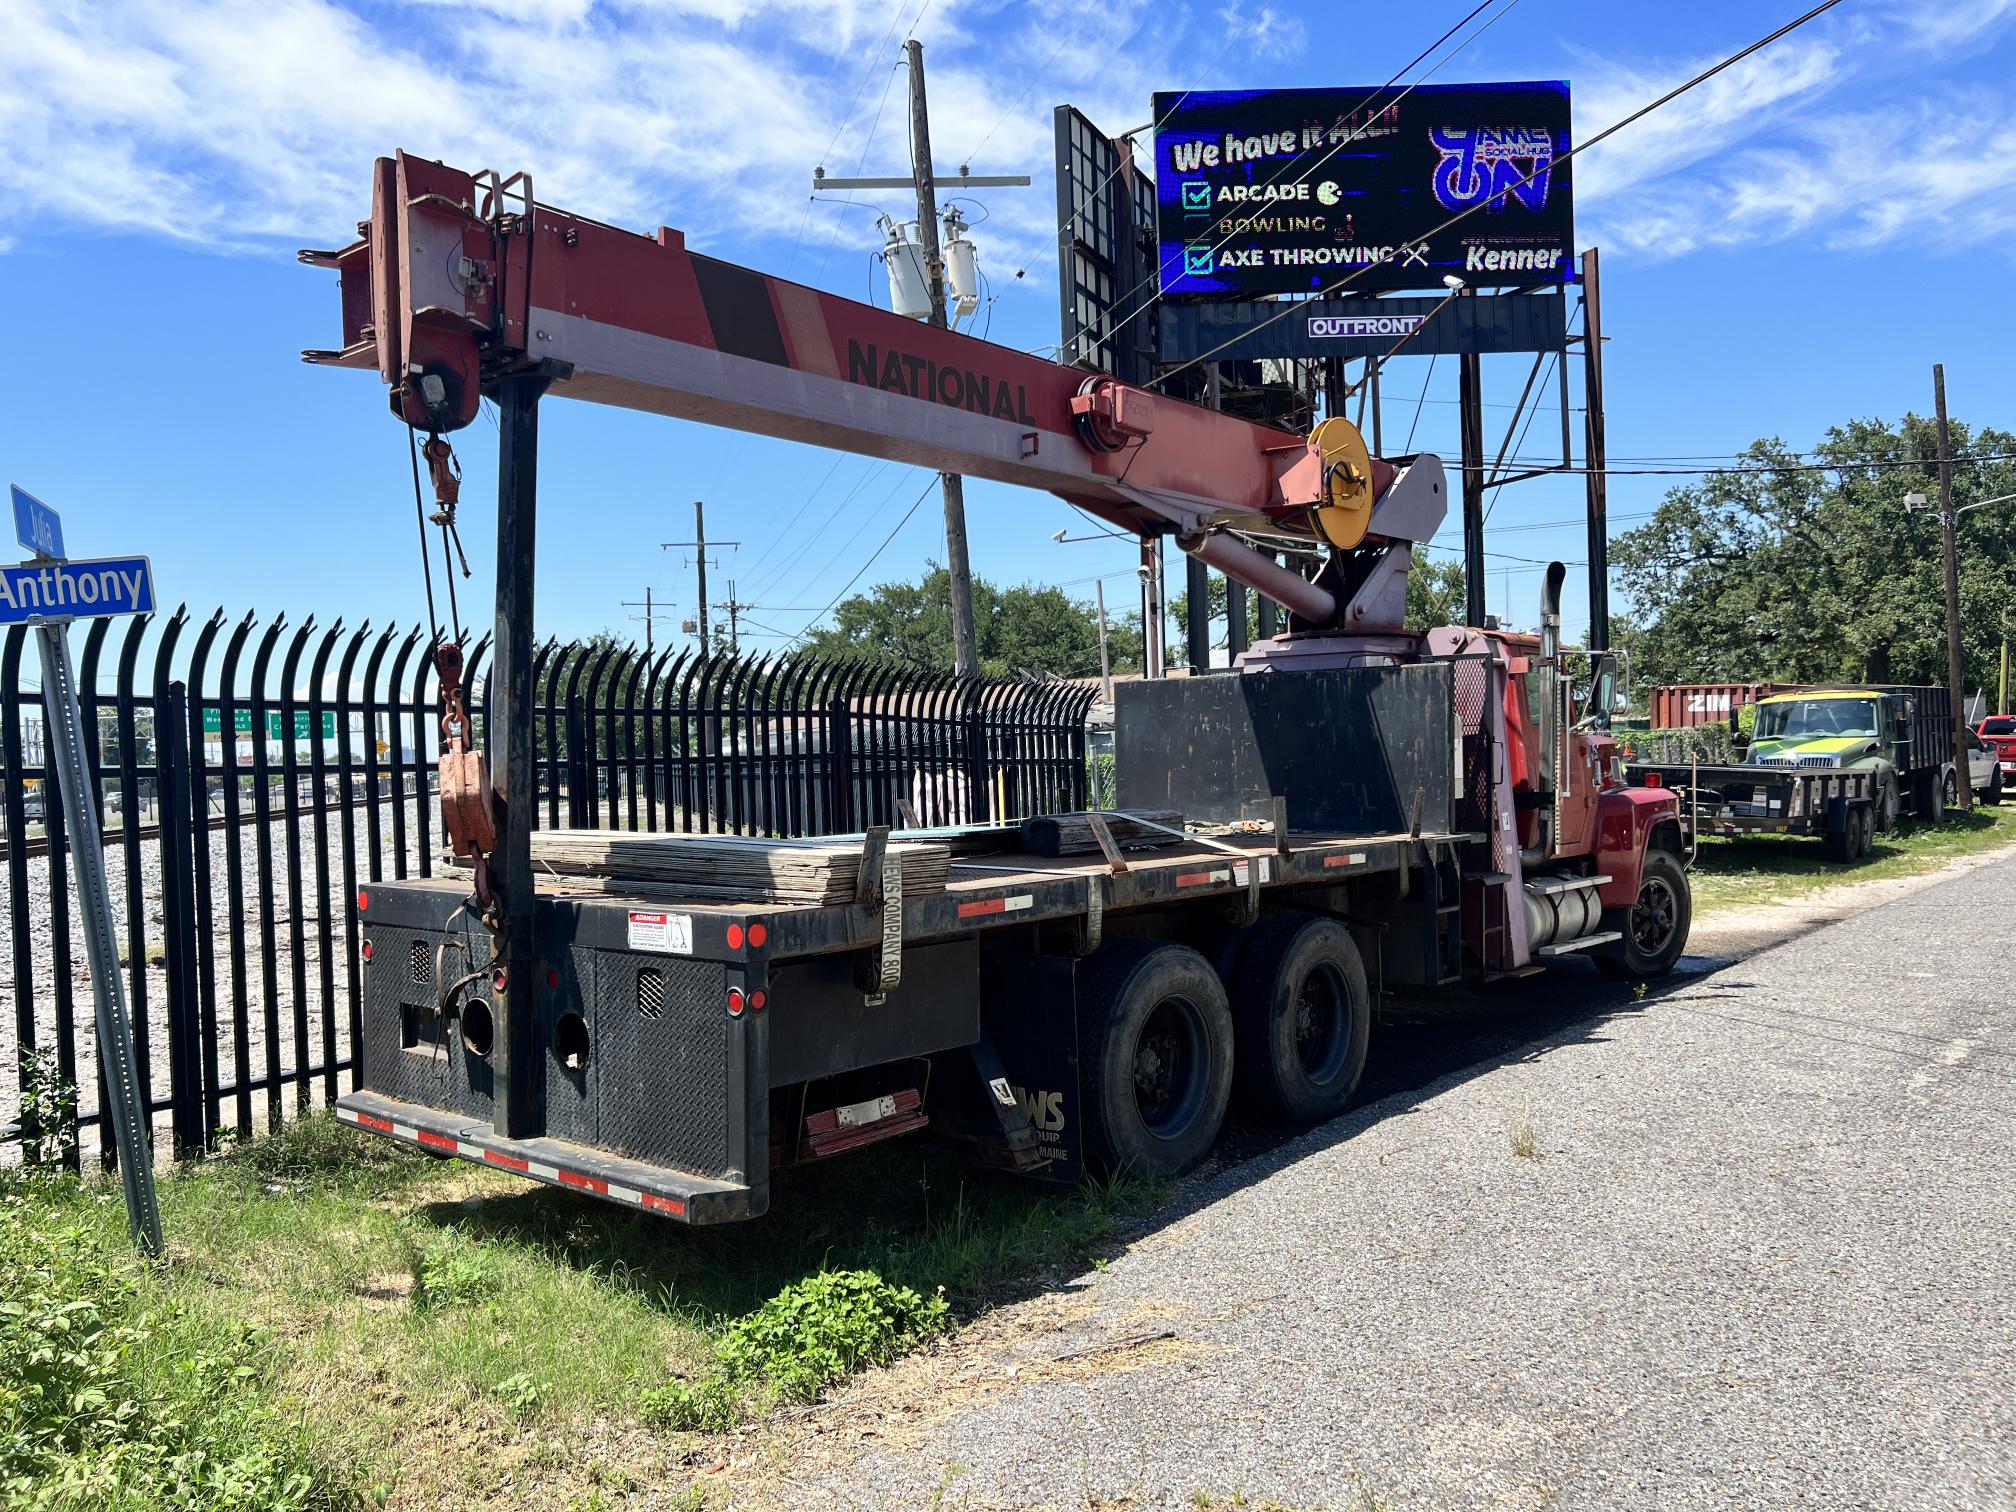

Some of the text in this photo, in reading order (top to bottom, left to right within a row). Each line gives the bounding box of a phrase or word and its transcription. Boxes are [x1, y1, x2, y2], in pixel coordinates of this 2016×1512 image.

[1173, 141, 1219, 172] We
[1225, 130, 1296, 163] have
[1486, 146, 1549, 157] SOCIAL HUB
[1216, 183, 1310, 202] ARCADE
[1219, 215, 1326, 234] BOWLING
[1219, 246, 1394, 267] AXE THROWING
[1466, 244, 1563, 272] Kenner
[1312, 318, 1419, 335] OUTFRONT
[848, 337, 1036, 428] NATIONAL
[30, 504, 54, 553] Julia
[1687, 694, 1731, 712] ZIM
[883, 857, 900, 894] HEWS
[883, 896, 901, 956] COMPANY
